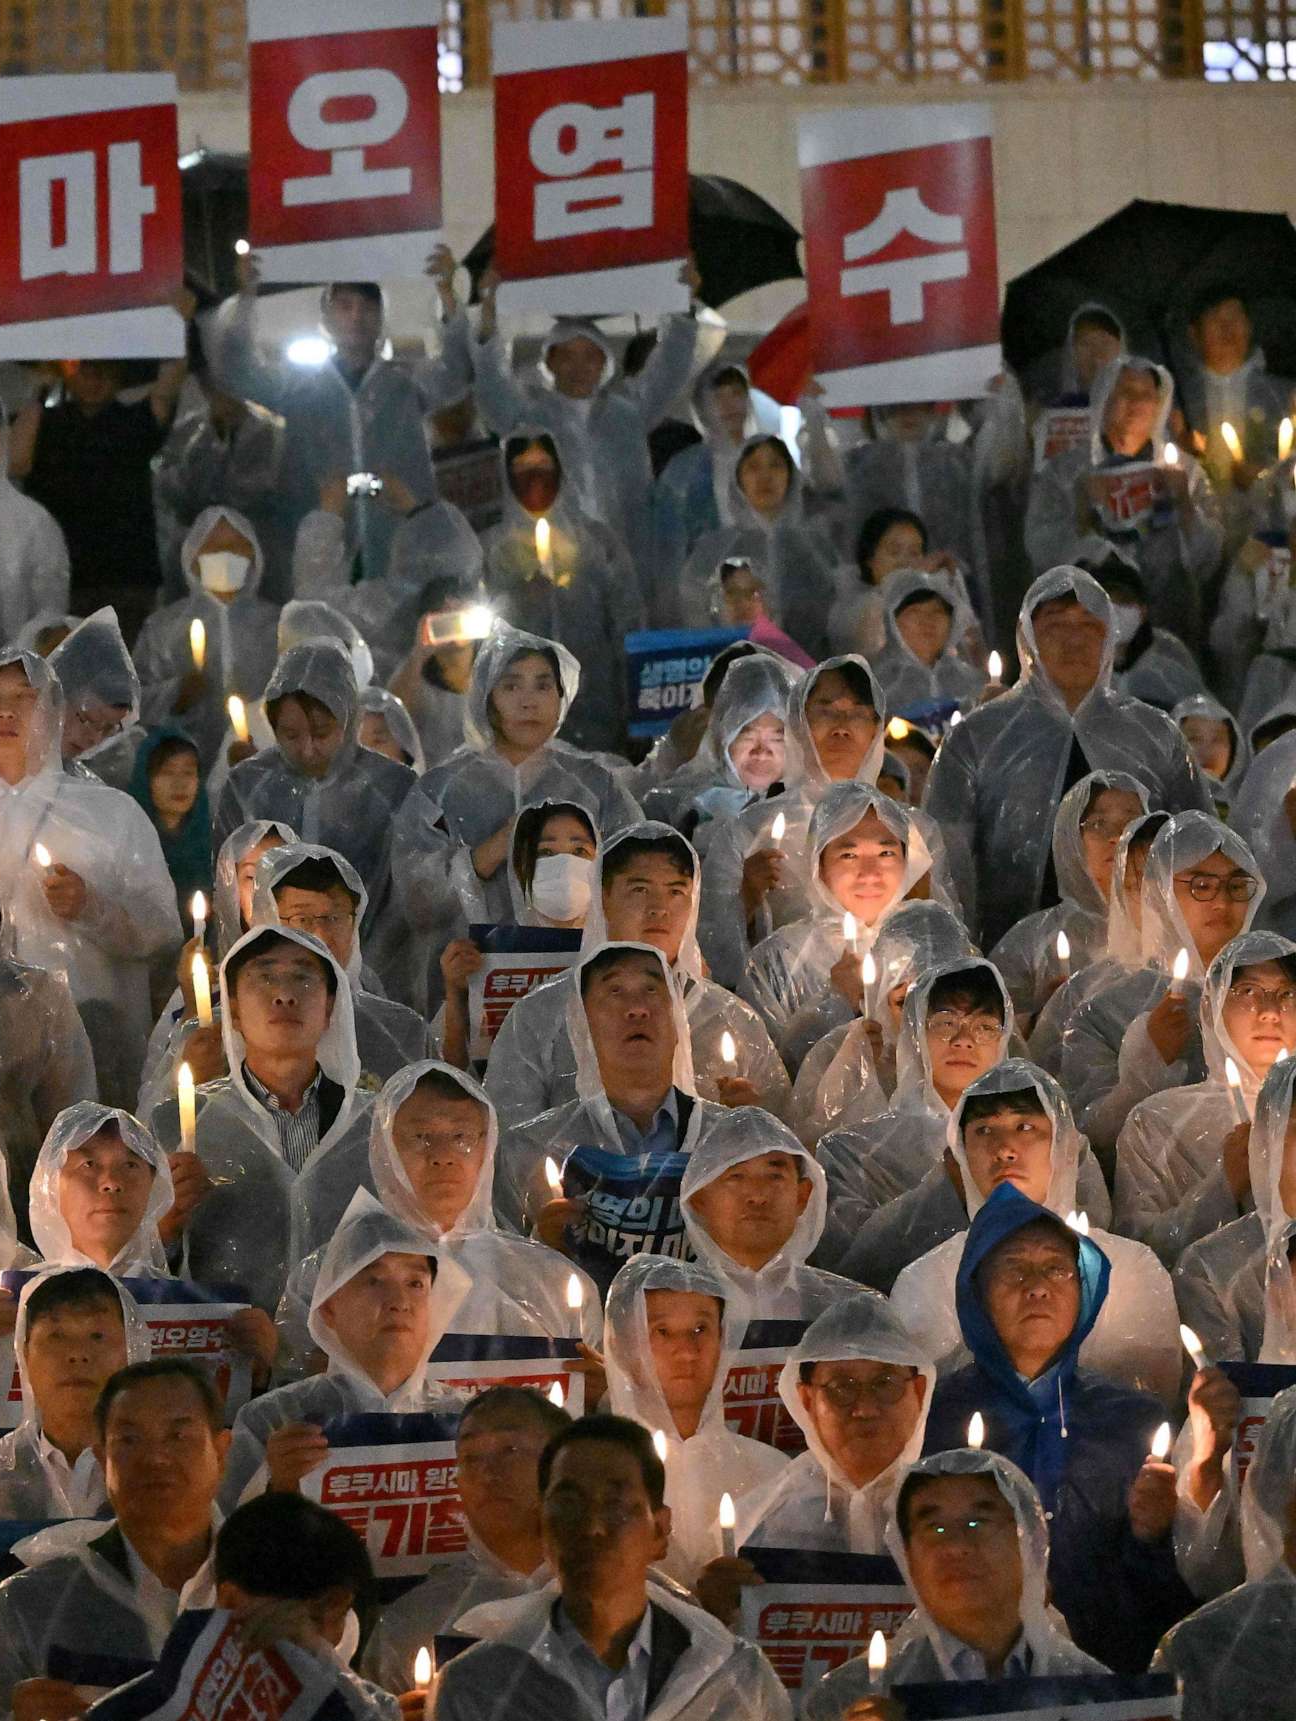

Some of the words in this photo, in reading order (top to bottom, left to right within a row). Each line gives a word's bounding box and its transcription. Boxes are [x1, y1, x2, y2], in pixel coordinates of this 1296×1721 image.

[283, 68, 412, 206] 오
[529, 93, 654, 241] 염
[19, 141, 156, 281] 마
[840, 186, 969, 325] 수
[327, 1469, 420, 1498] 후쿠시마
[765, 1610, 864, 1635] 후쿠시마
